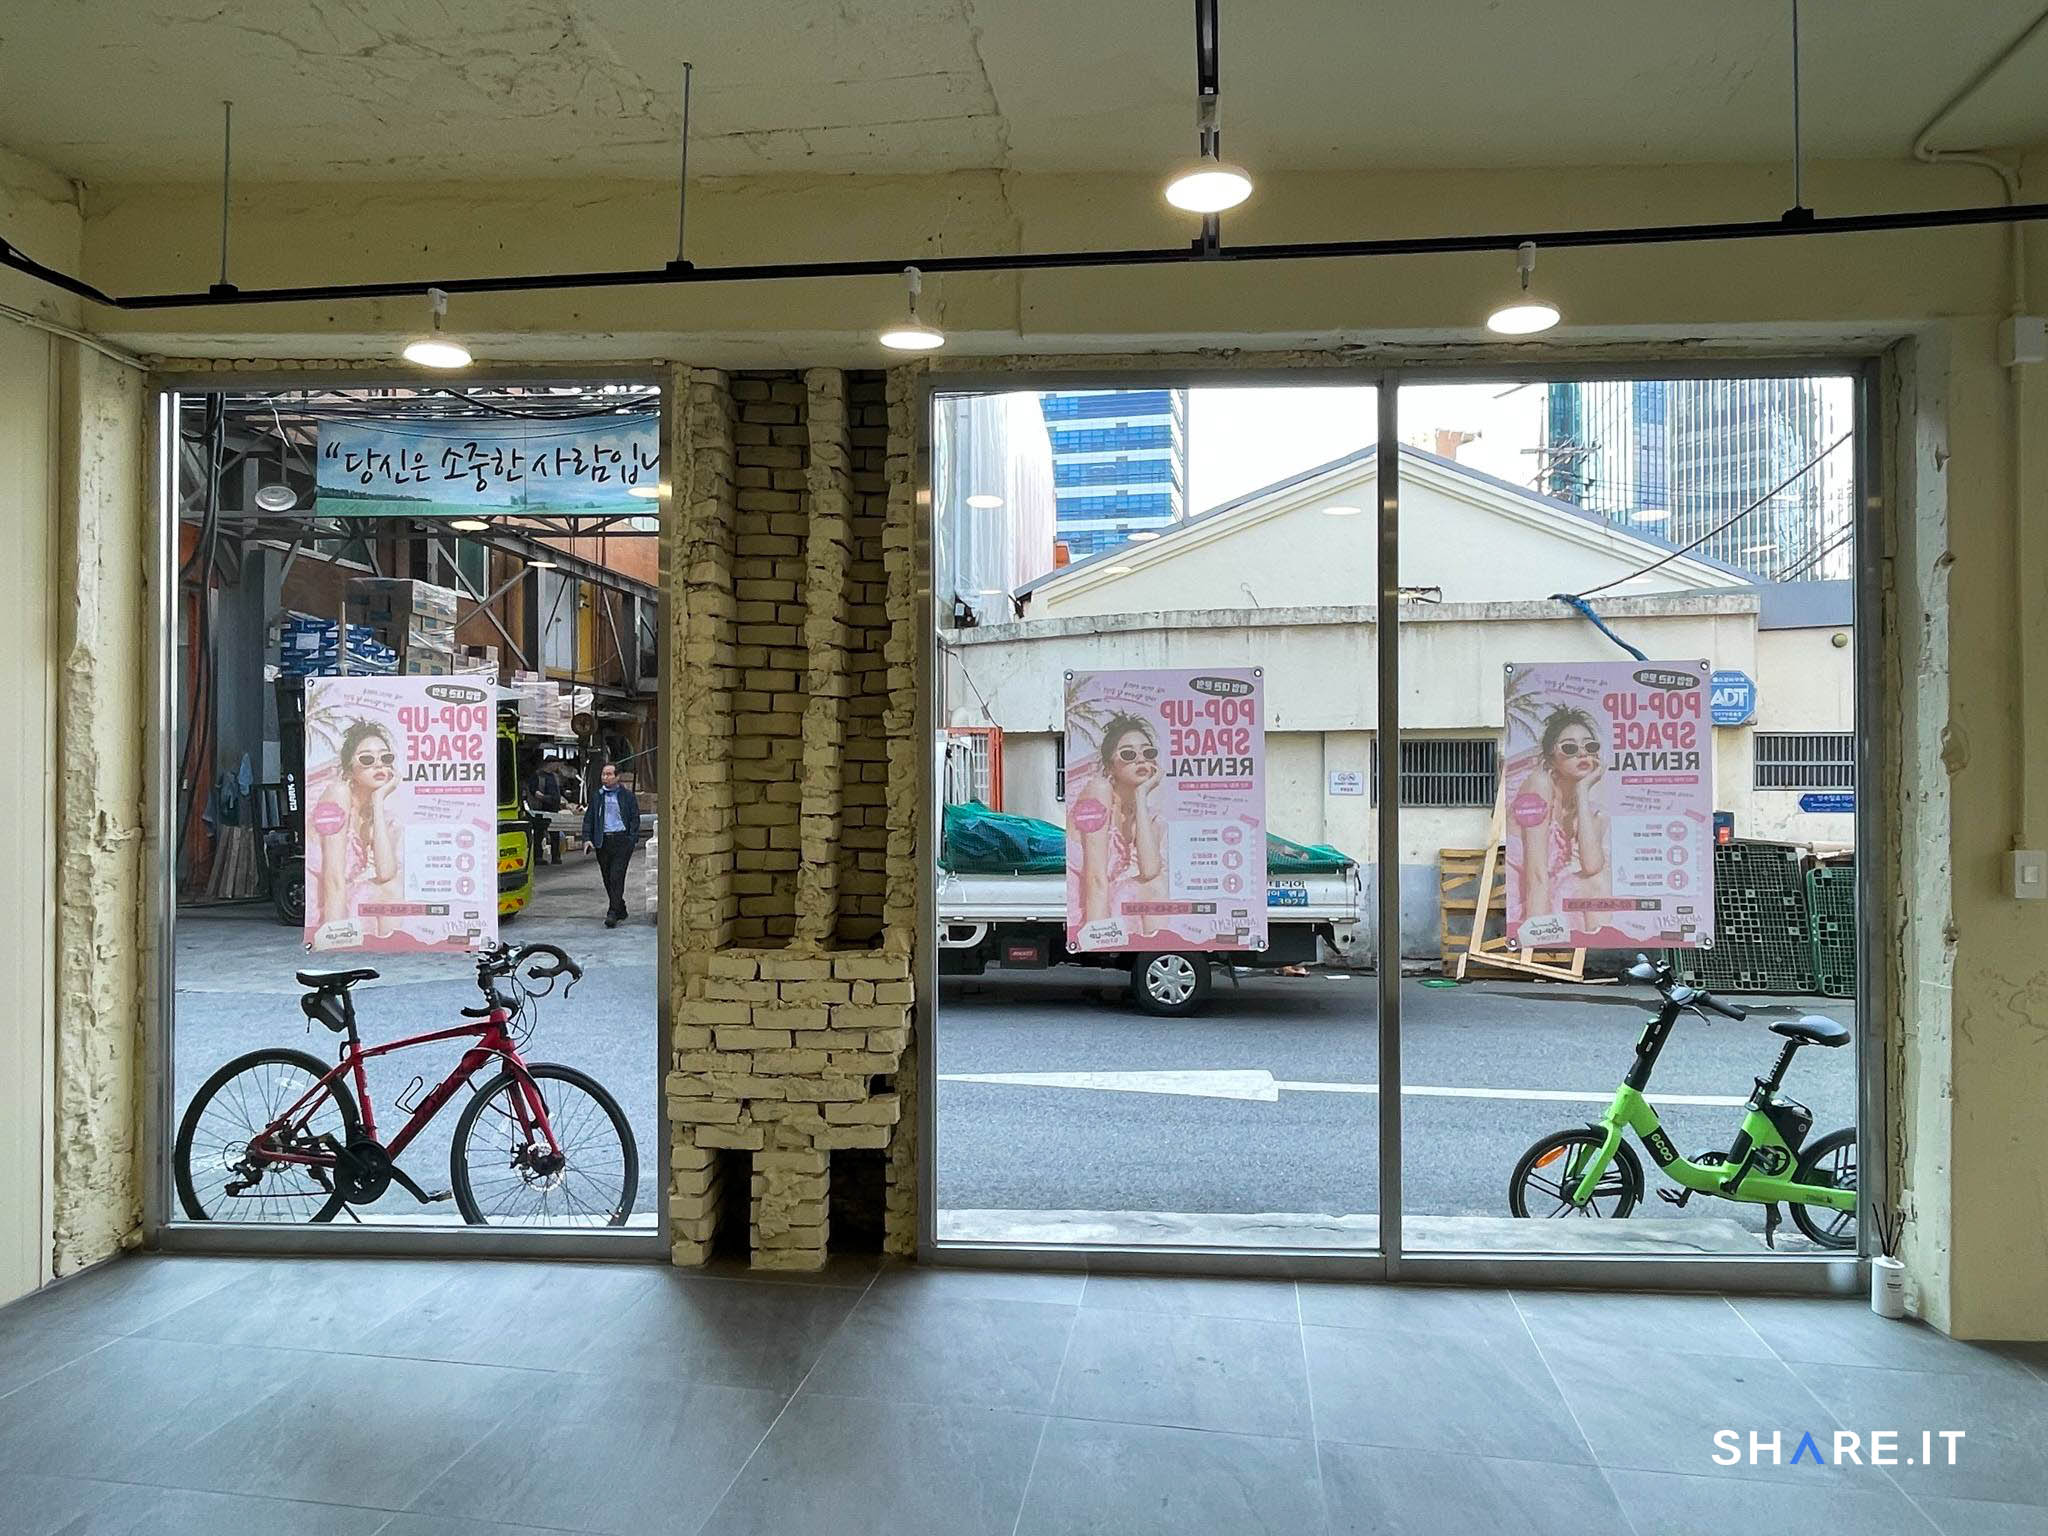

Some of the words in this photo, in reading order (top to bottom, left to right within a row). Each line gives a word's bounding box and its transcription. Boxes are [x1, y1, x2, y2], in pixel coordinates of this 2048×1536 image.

[440, 442, 525, 492] 소중한
[1711, 687, 1747, 706] ADT
[1651, 1133, 1674, 1161] GCOO
